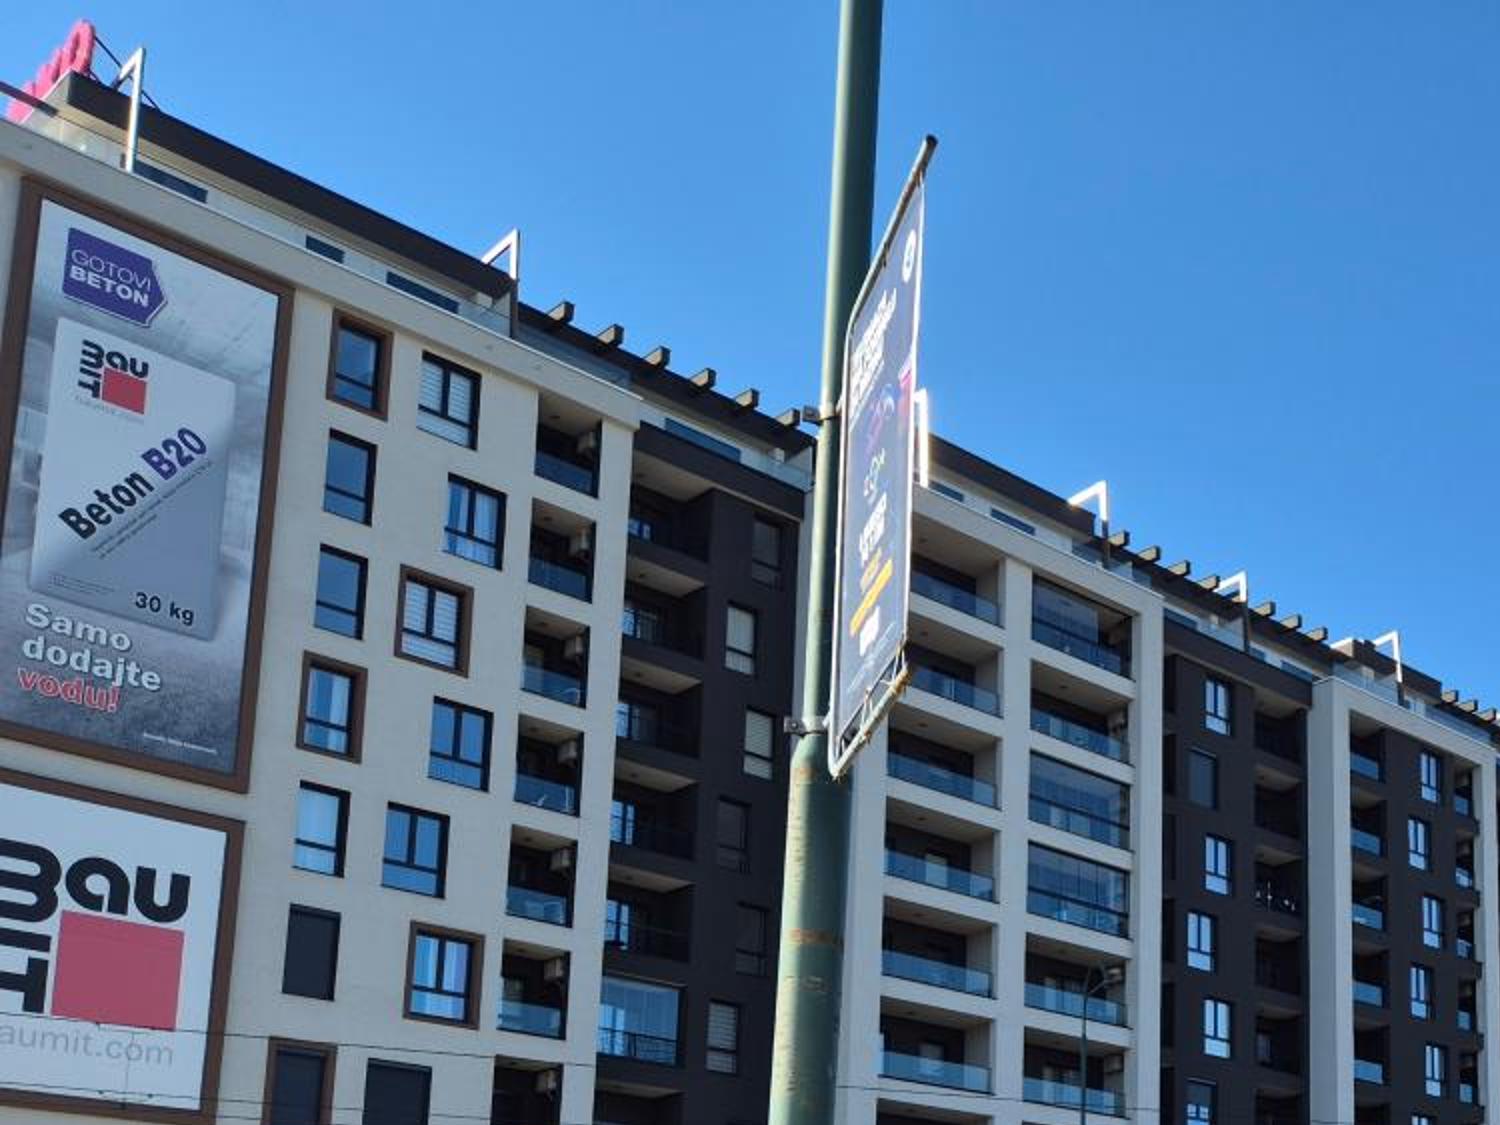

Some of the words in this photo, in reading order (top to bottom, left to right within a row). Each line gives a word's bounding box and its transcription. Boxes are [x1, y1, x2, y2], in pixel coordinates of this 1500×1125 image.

[69, 265, 149, 307] BETON
[71, 249, 151, 292] GOTOVI
[58, 472, 154, 539] Beton
[141, 427, 207, 480] B20
[25, 603, 132, 652] Samo
[135, 592, 162, 613] 30
[169, 602, 195, 627] kg
[22, 636, 162, 692] dodajte
[17, 667, 120, 713] vodu!
[0, 1022, 174, 1065] aumit.com
